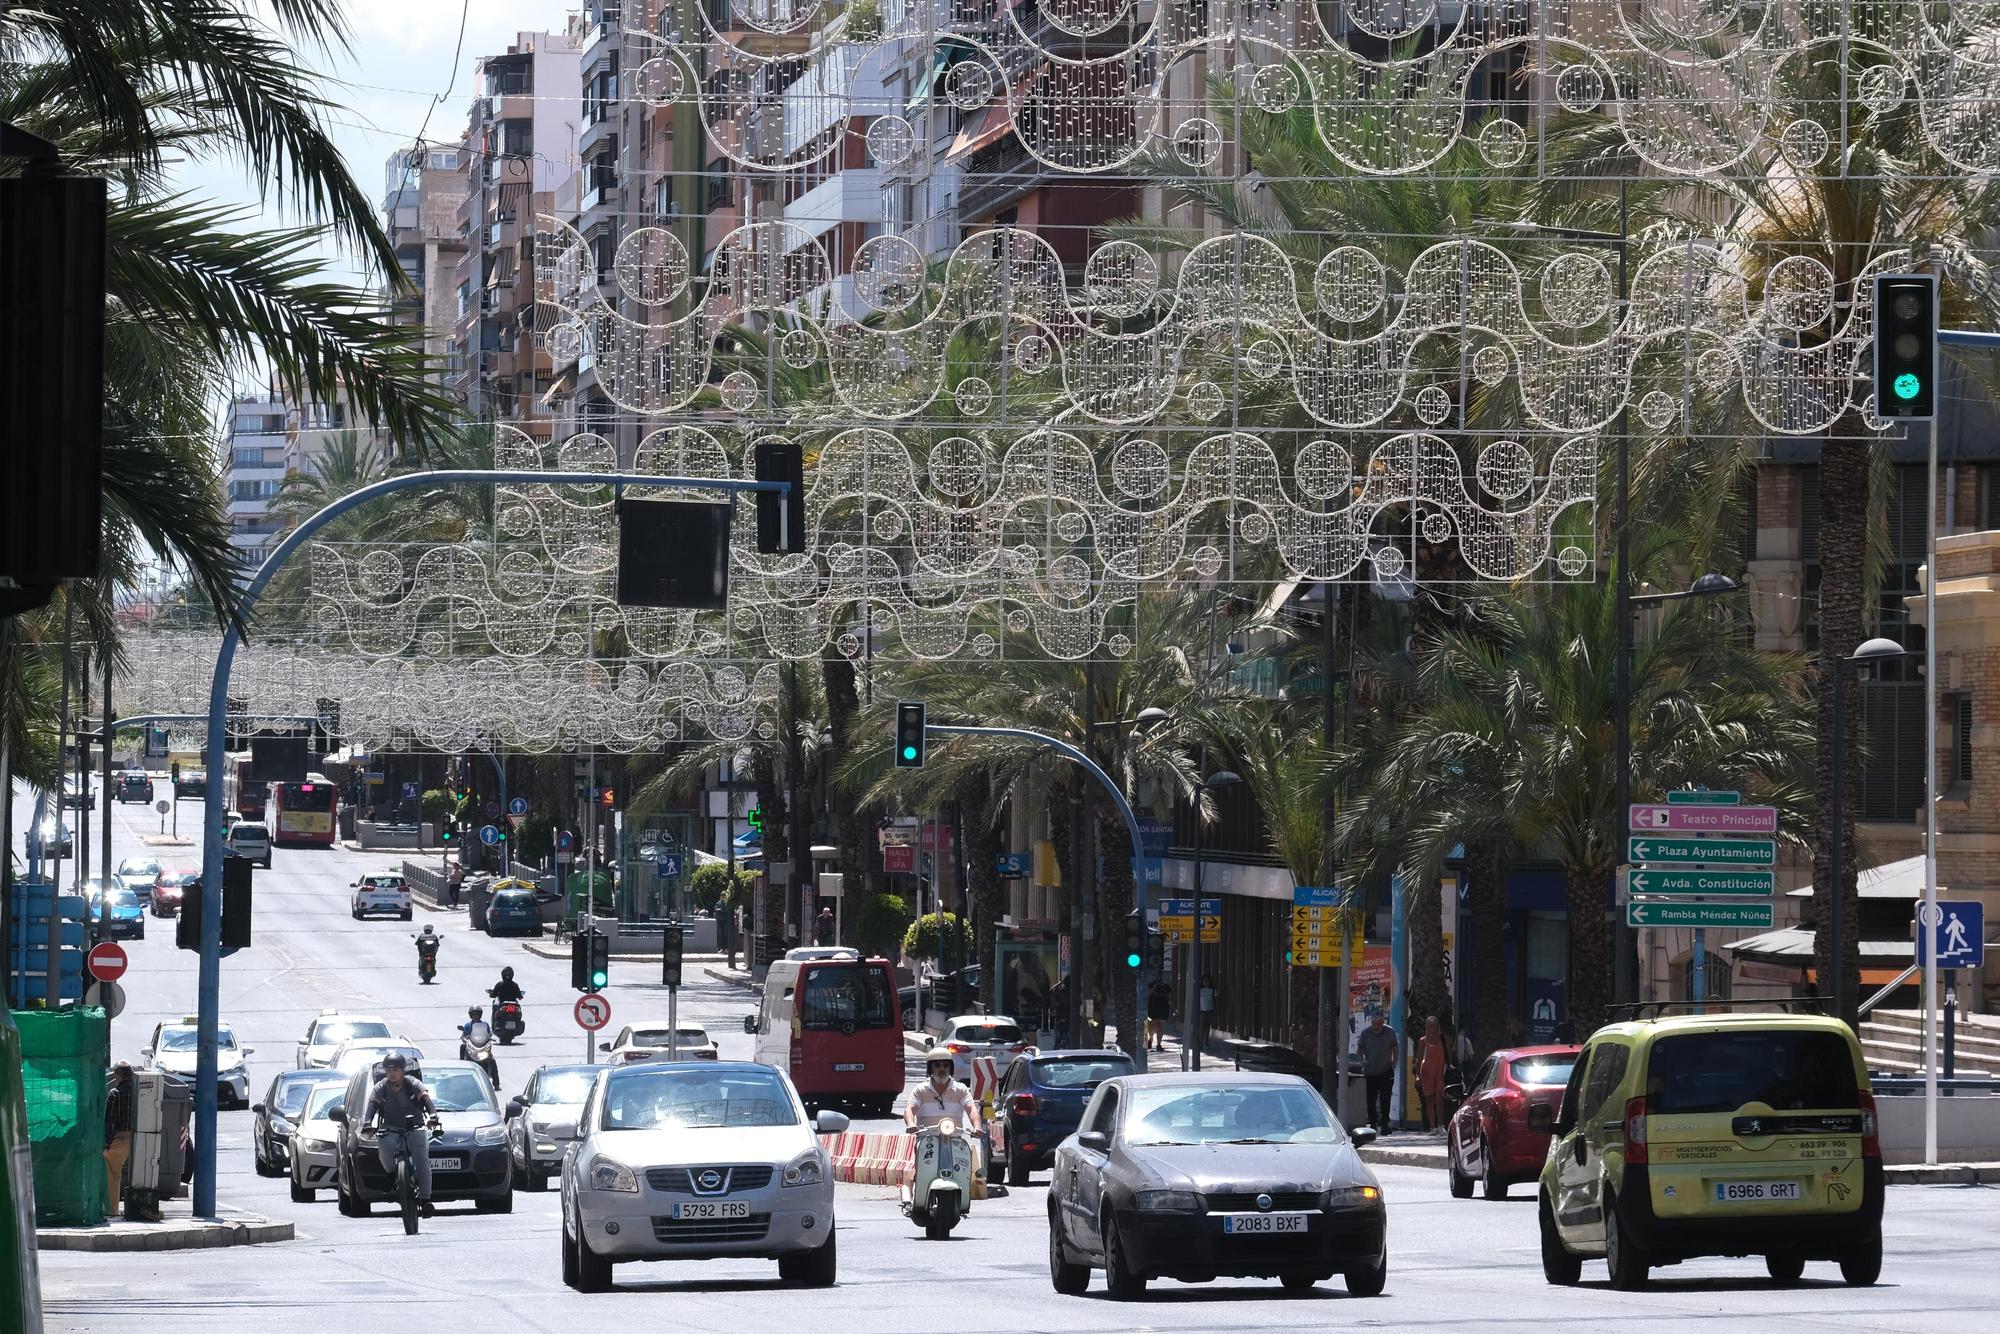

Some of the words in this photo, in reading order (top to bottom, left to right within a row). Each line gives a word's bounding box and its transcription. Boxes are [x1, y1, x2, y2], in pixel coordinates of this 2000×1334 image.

[1681, 814, 1718, 825] Teatro
[1722, 814, 1772, 827] Principal
[1657, 845, 1688, 856] Plaza
[1692, 846, 1771, 858] Ayuntamiento
[1662, 878, 1694, 889] Avda.
[1698, 877, 1771, 889] Constitución
[1661, 909, 1696, 919] Rambla
[1700, 909, 1737, 920] Méndez
[1740, 909, 1770, 920] Núñez
[1676, 1144, 1733, 1153] MULTISERVICIOS
[1676, 1151, 1718, 1159] VERTICALES
[1728, 1184, 1764, 1199] 6966
[1770, 1183, 1797, 1197] GRT
[683, 1202, 716, 1217] 5792
[721, 1202, 747, 1216] FRS
[1236, 1217, 1272, 1232] 2083
[1276, 1216, 1303, 1231] BXF
